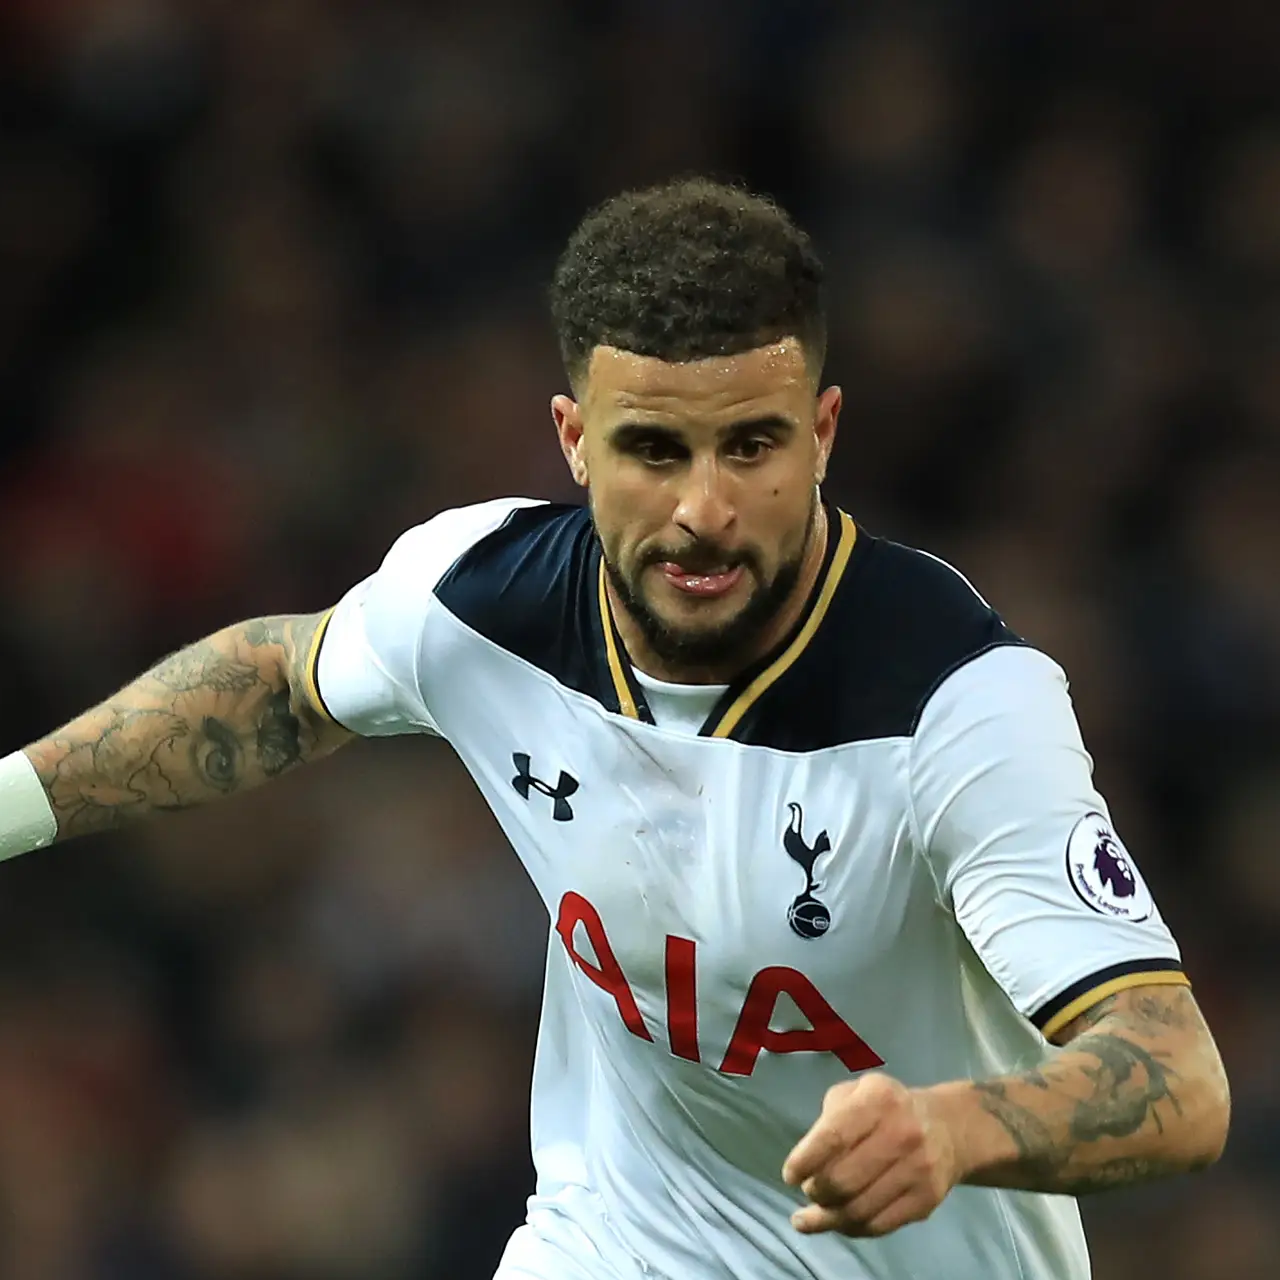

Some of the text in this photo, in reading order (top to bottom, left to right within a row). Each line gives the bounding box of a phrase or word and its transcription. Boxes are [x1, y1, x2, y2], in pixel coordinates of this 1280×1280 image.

[1075, 863, 1130, 914] Premier League
[556, 890, 885, 1077] AIA
